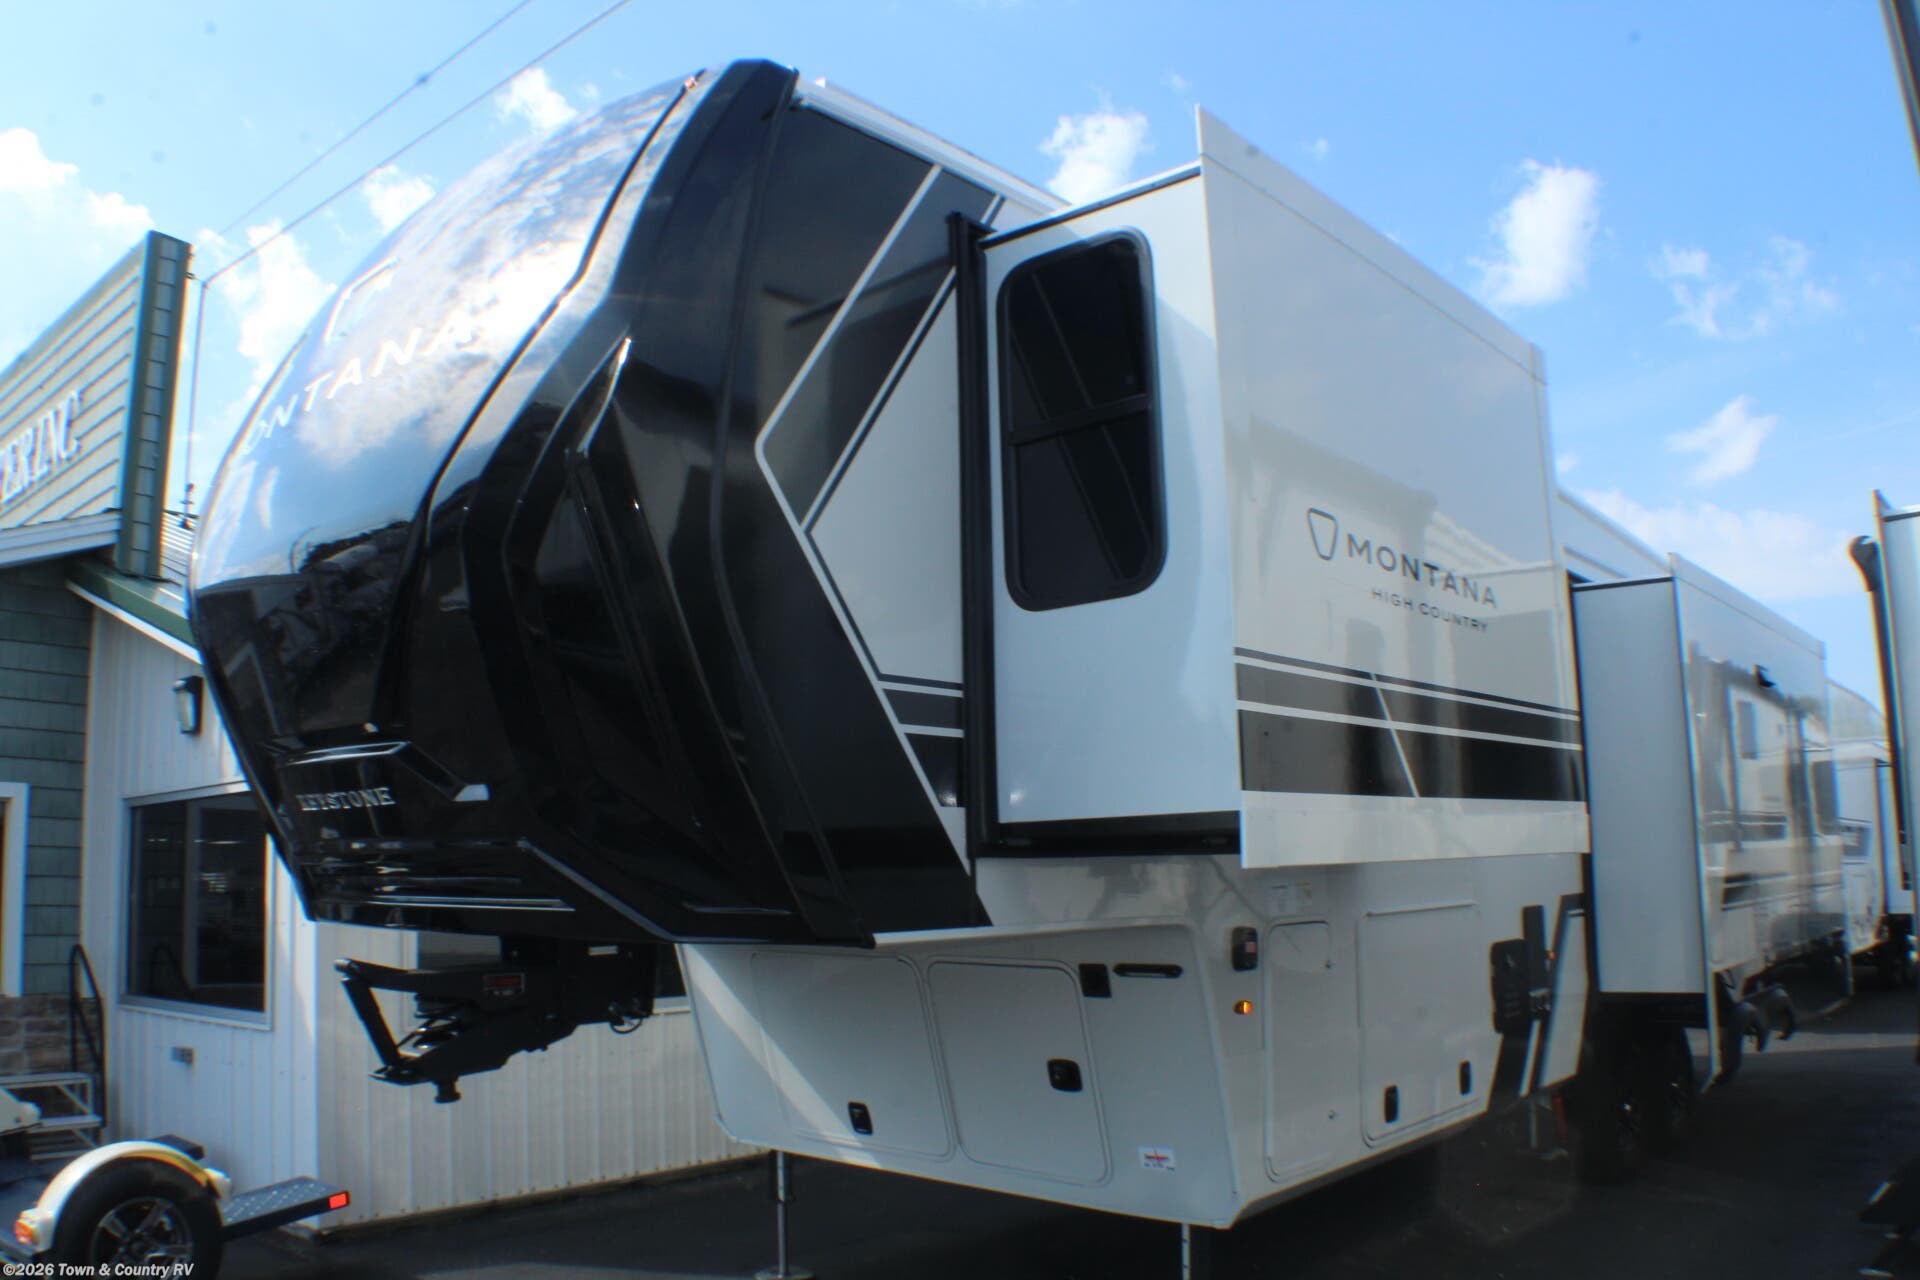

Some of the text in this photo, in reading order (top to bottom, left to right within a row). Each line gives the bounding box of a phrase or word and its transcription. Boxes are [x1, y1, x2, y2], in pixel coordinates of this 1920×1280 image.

[240, 308, 473, 457] ONTANA
[1346, 533, 1497, 608] MONTANA
[1371, 588, 1489, 633] HIGH COUNTRY
